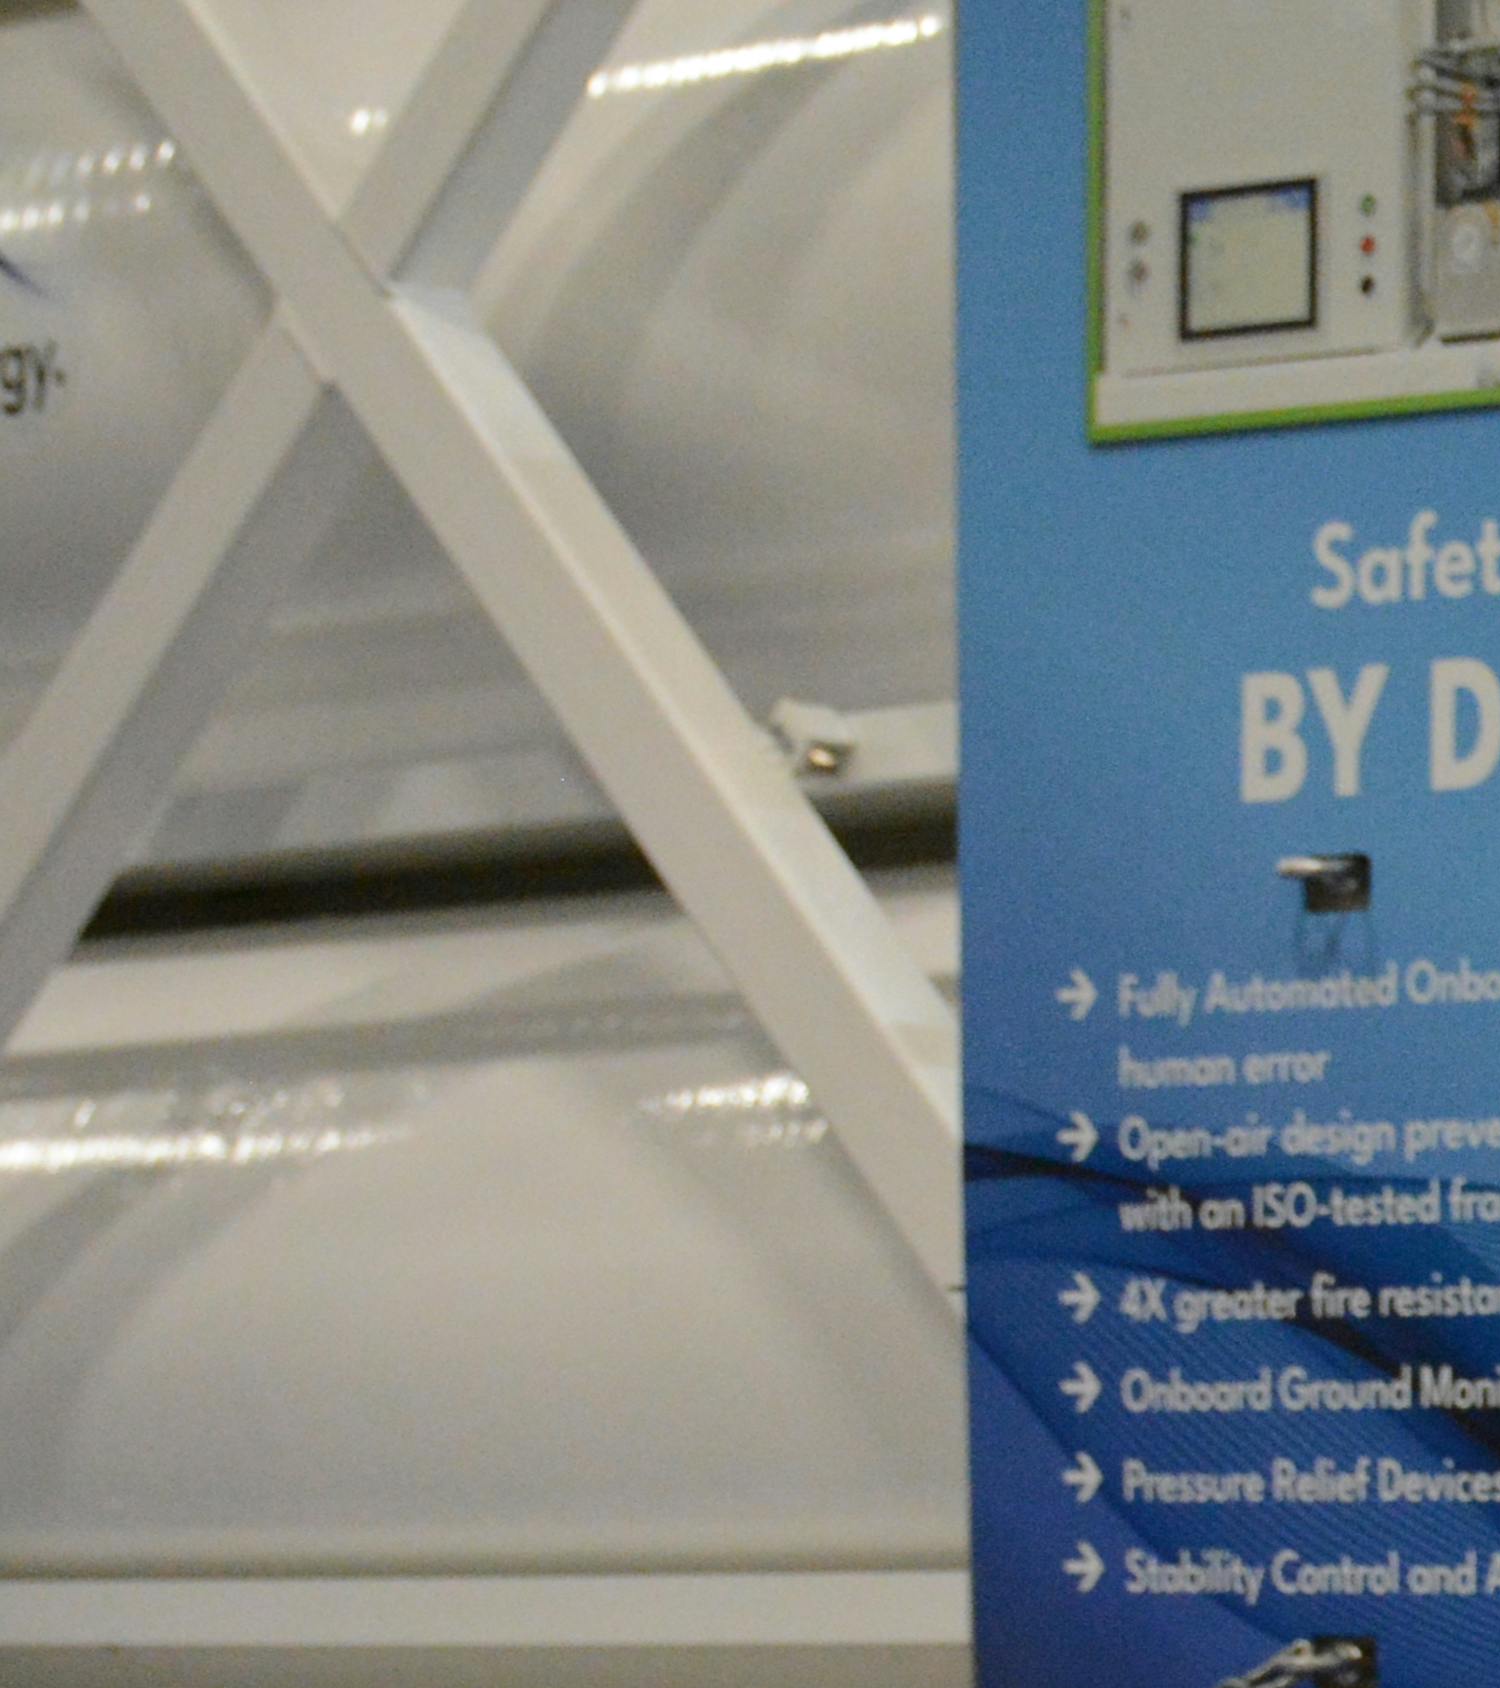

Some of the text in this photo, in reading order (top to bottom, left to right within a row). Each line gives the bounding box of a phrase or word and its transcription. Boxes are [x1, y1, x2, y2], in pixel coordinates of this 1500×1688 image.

[1240, 663, 1390, 802] BY
[1118, 969, 1197, 1028] Fully
[1205, 960, 1397, 1014] Automated
[1117, 1045, 1332, 1088] human error
[1118, 1112, 1273, 1170] Open-air
[1281, 1107, 1397, 1166] design
[1119, 1185, 1194, 1231] with
[1200, 1199, 1246, 1230] an
[1252, 1178, 1441, 1229] ISO-tested
[1120, 1277, 1168, 1323] 4X
[1172, 1281, 1303, 1334] greater
[1310, 1270, 1371, 1319] fire
[1119, 1364, 1273, 1414] Onboard
[1279, 1362, 1413, 1412] Ground
[1122, 1458, 1266, 1503] Pressure
[1272, 1454, 1371, 1502] Relief
[1125, 1546, 1266, 1606] Stability
[1270, 1546, 1400, 1596] Control
[1406, 1549, 1478, 1596] and
